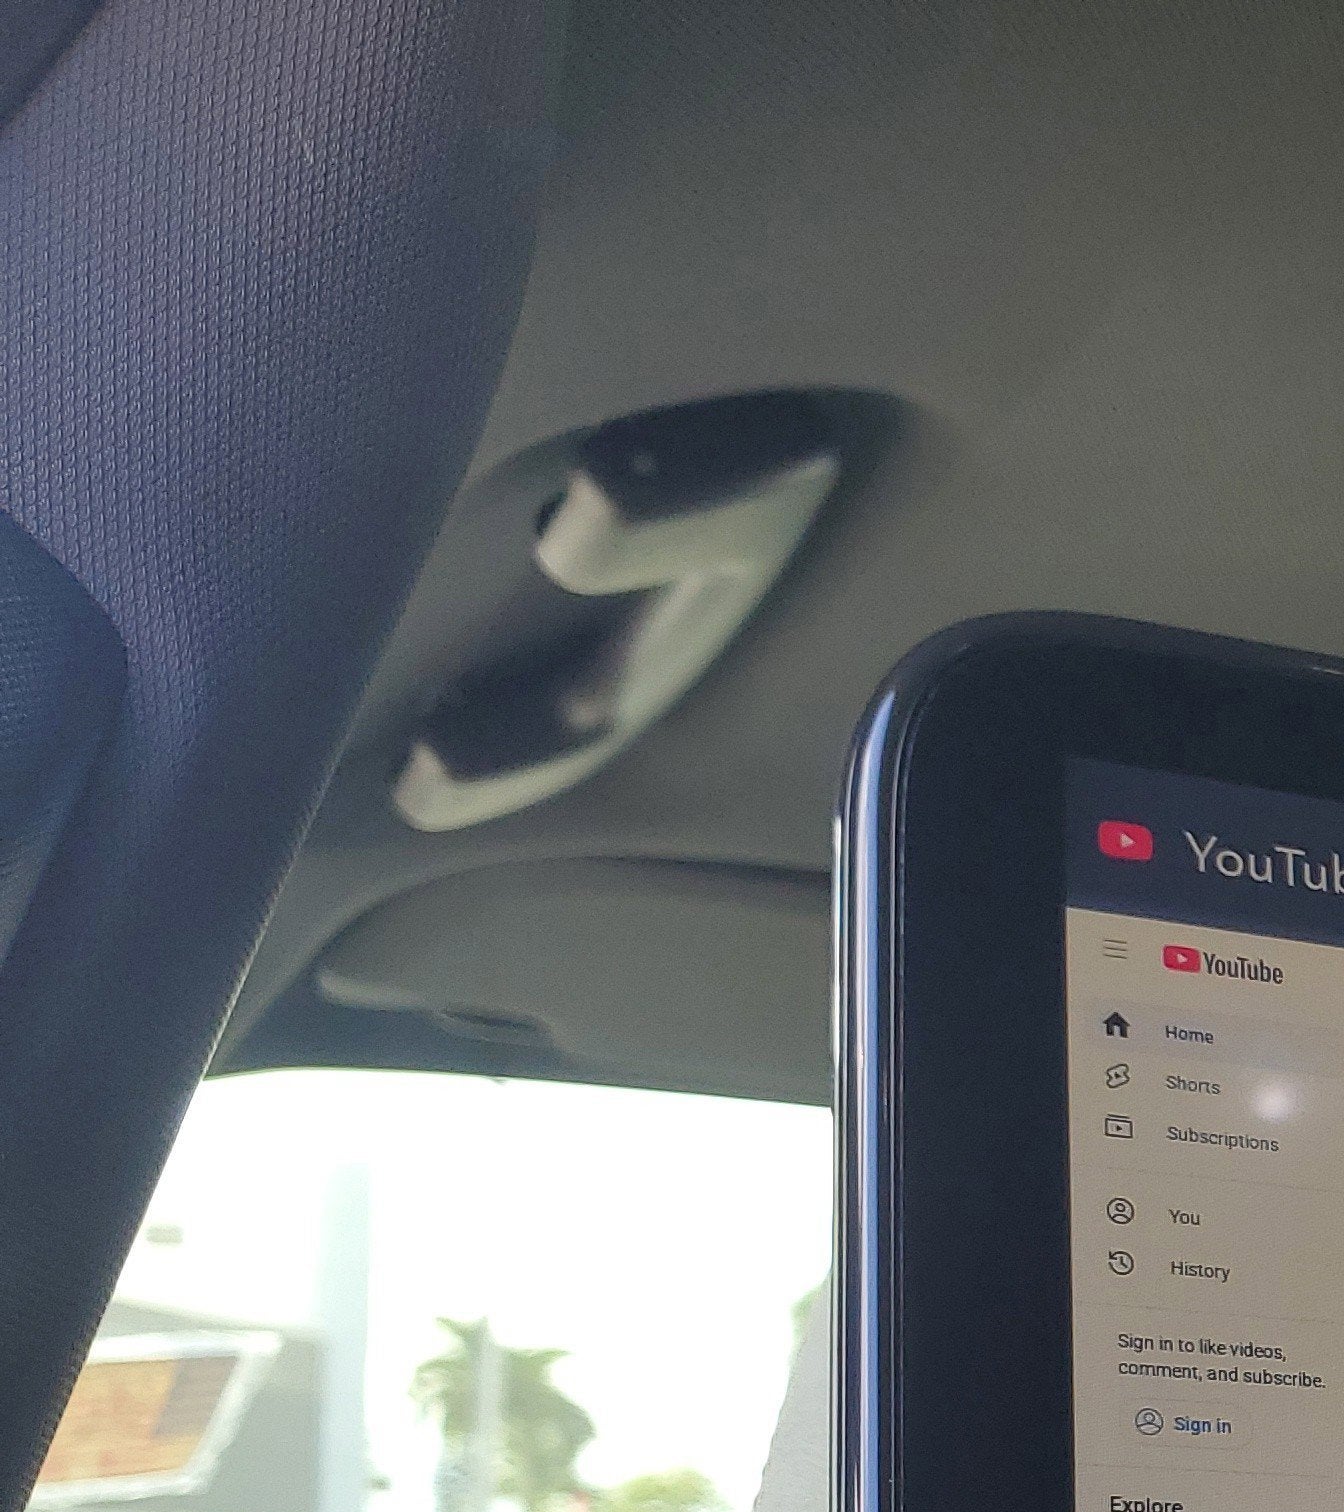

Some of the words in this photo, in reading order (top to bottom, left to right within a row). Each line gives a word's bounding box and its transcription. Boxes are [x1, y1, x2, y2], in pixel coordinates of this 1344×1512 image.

[1203, 951, 1284, 984] YouTube
[1165, 1025, 1215, 1044] Home
[1166, 1075, 1221, 1095] Shorts
[1167, 1126, 1280, 1152] Subscriptions
[1169, 1208, 1201, 1227] You
[1170, 1259, 1231, 1283] History
[1118, 1333, 1154, 1353] Sign
[1159, 1336, 1174, 1351] in
[1178, 1339, 1195, 1353] to
[1199, 1339, 1226, 1356] like
[1229, 1342, 1287, 1362] videos,
[1118, 1362, 1203, 1382] comment,
[1206, 1367, 1239, 1383] and
[1243, 1369, 1326, 1388] subscribe.
[1173, 1416, 1212, 1435] Sign
[1216, 1418, 1232, 1434] in
